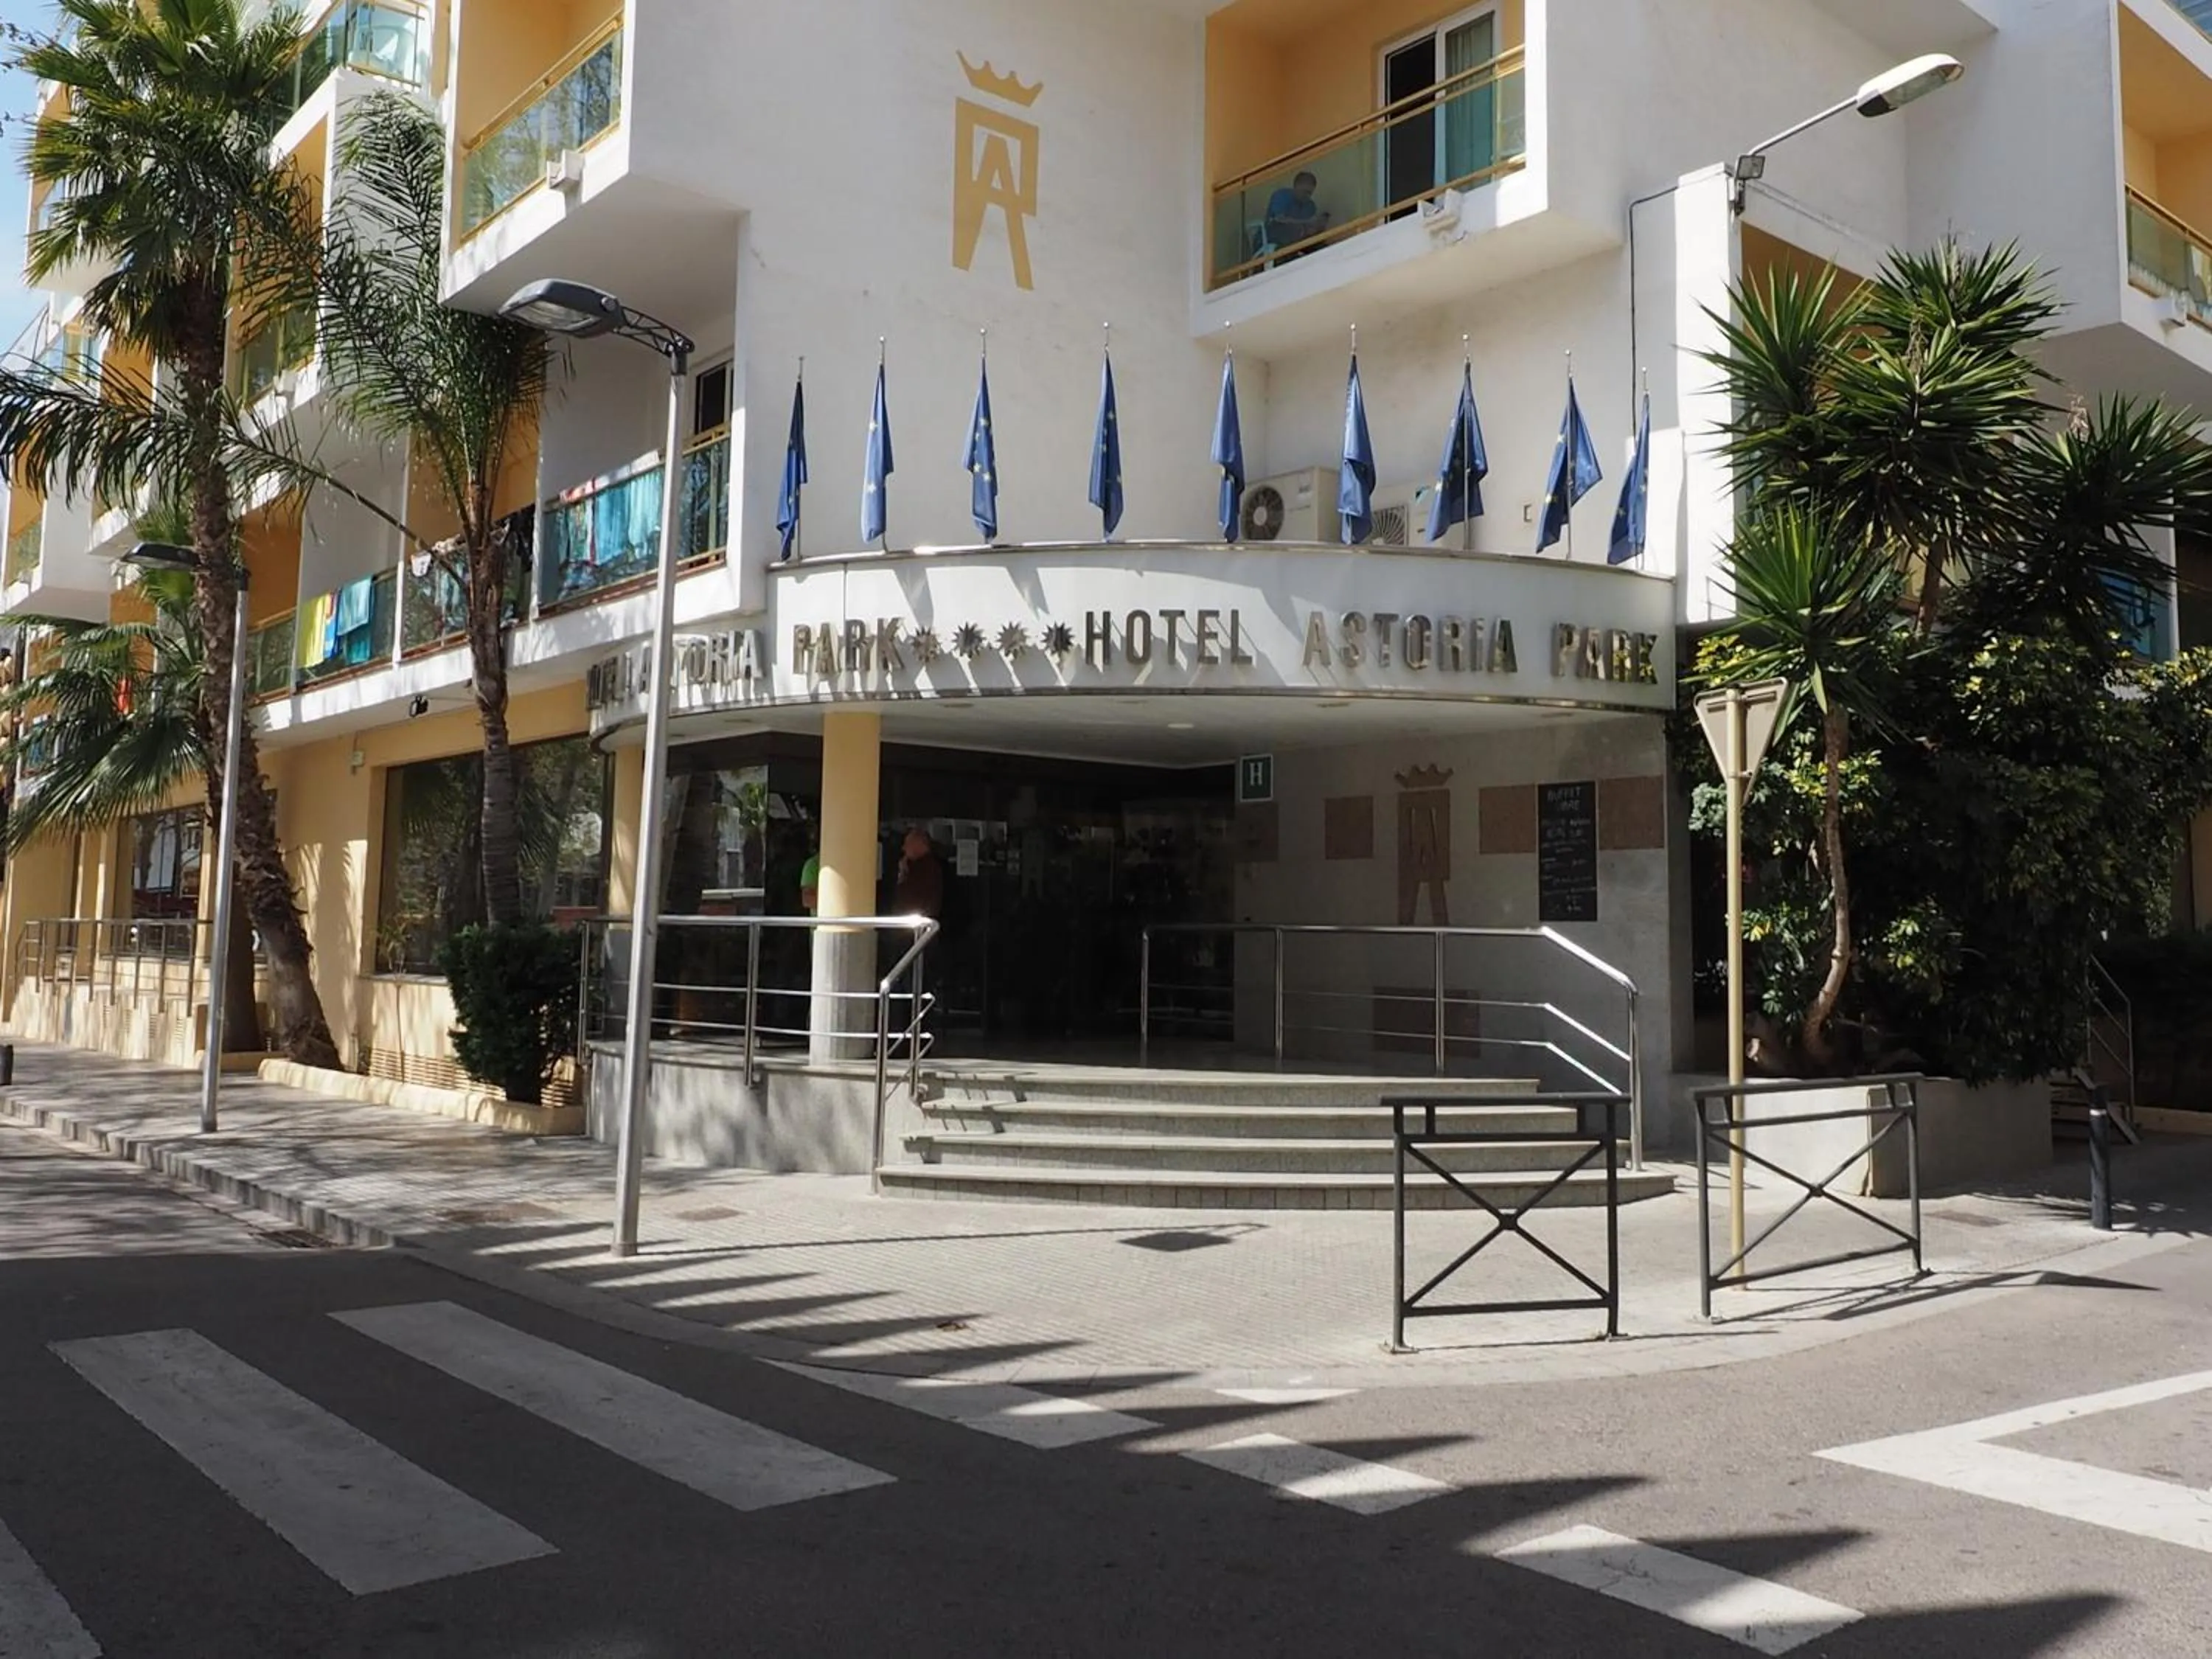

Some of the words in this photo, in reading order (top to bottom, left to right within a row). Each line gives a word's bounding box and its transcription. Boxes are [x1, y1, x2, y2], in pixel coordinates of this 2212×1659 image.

[637, 628, 762, 695] ATORIA
[793, 617, 905, 675] PARK
[1085, 609, 1253, 667] HOTEL
[1303, 611, 1518, 675] ASTORIA
[1552, 620, 1658, 685] PARK
[1249, 762, 1263, 785] H
